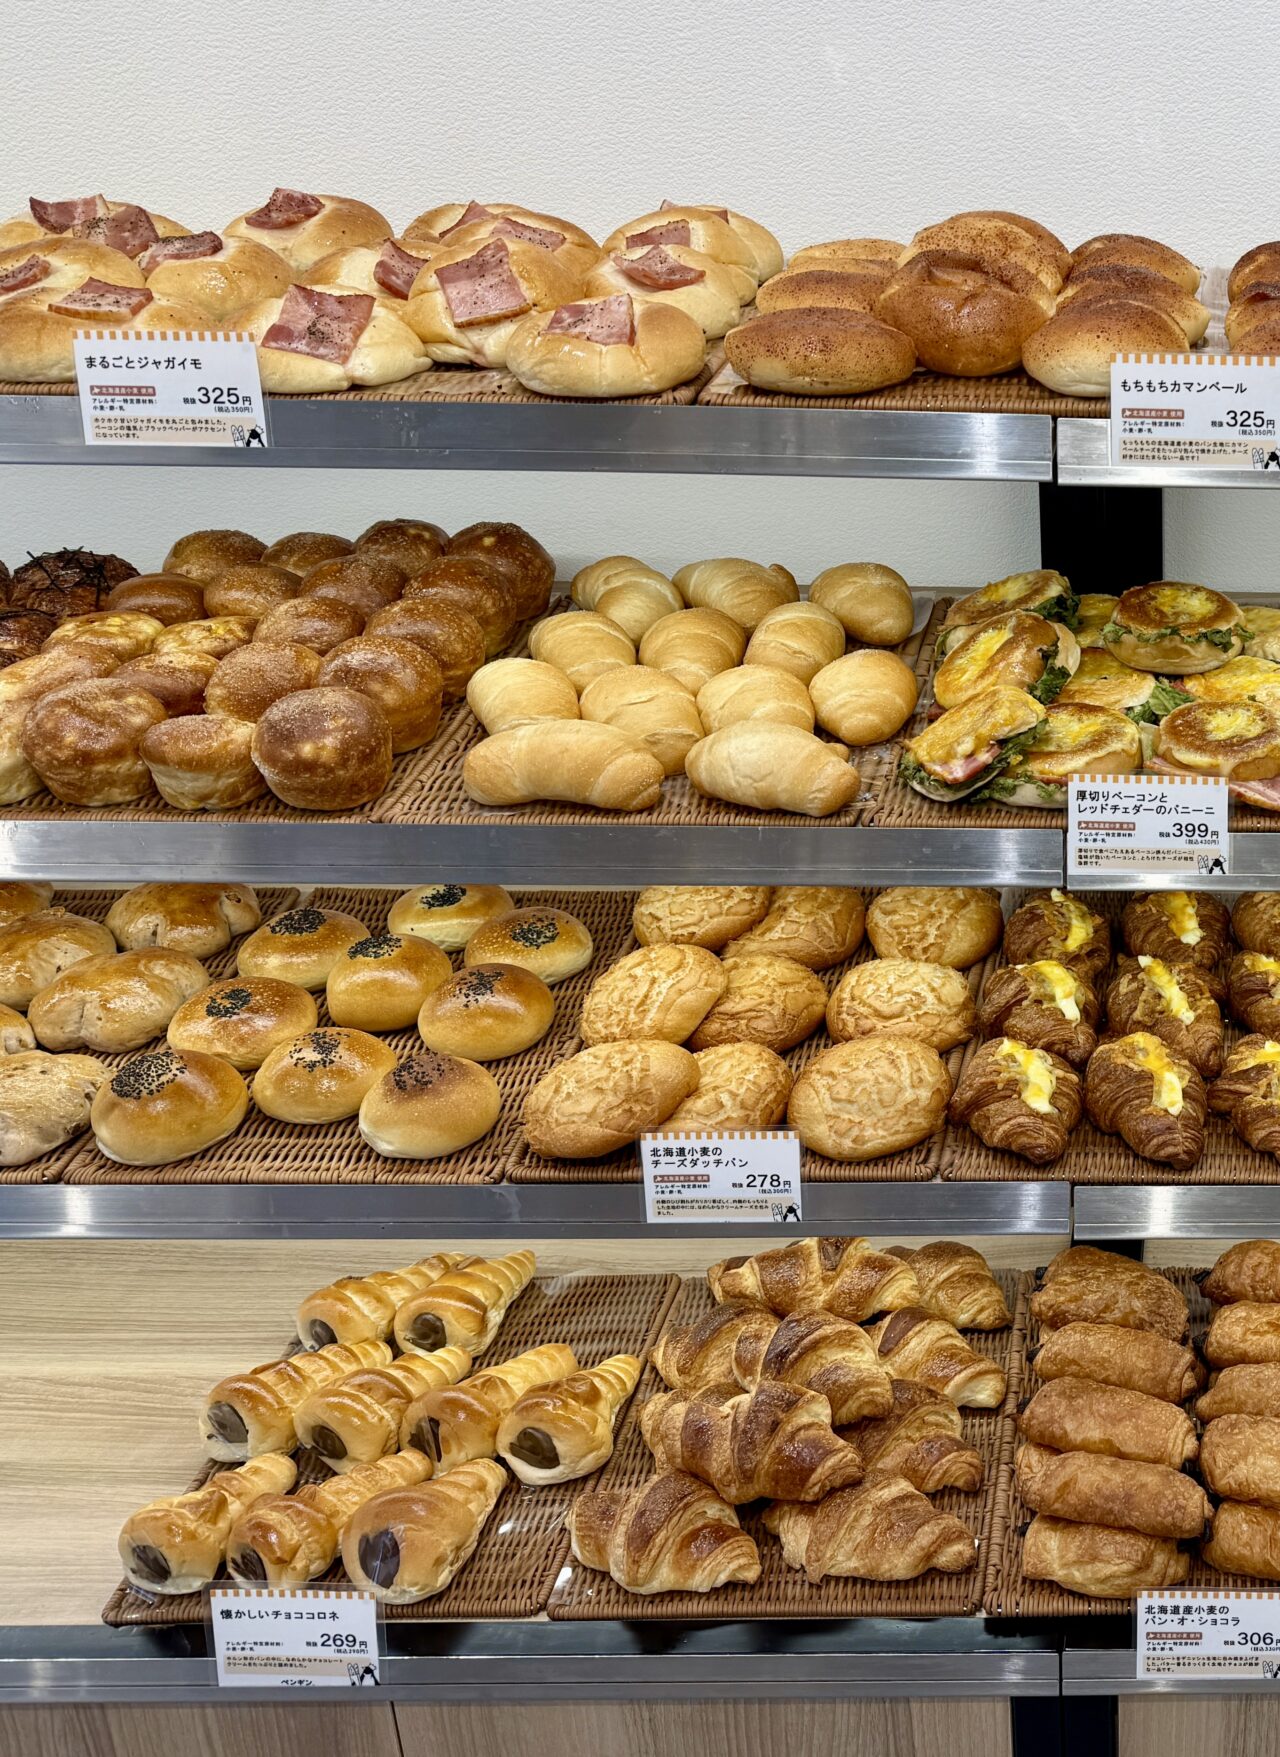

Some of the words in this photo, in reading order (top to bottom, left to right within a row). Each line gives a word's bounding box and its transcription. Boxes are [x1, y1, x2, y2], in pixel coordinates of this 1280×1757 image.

[84, 355, 202, 370] まるごとジャガイモ
[1121, 379, 1247, 394] もちもちカマンベール
[1076, 790, 1168, 803] 厚切りベーコンと
[1078, 803, 1215, 815] レッドチェダーのパニーニ
[650, 1147, 723, 1158] 北海道小麦の
[651, 1157, 748, 1169] チーズダッチパン
[220, 1609, 340, 1622] 懐かしいチョココロネ
[1145, 1605, 1230, 1615] 北海道産小麦の
[1145, 1616, 1241, 1627] パン・オ・ショコラ
